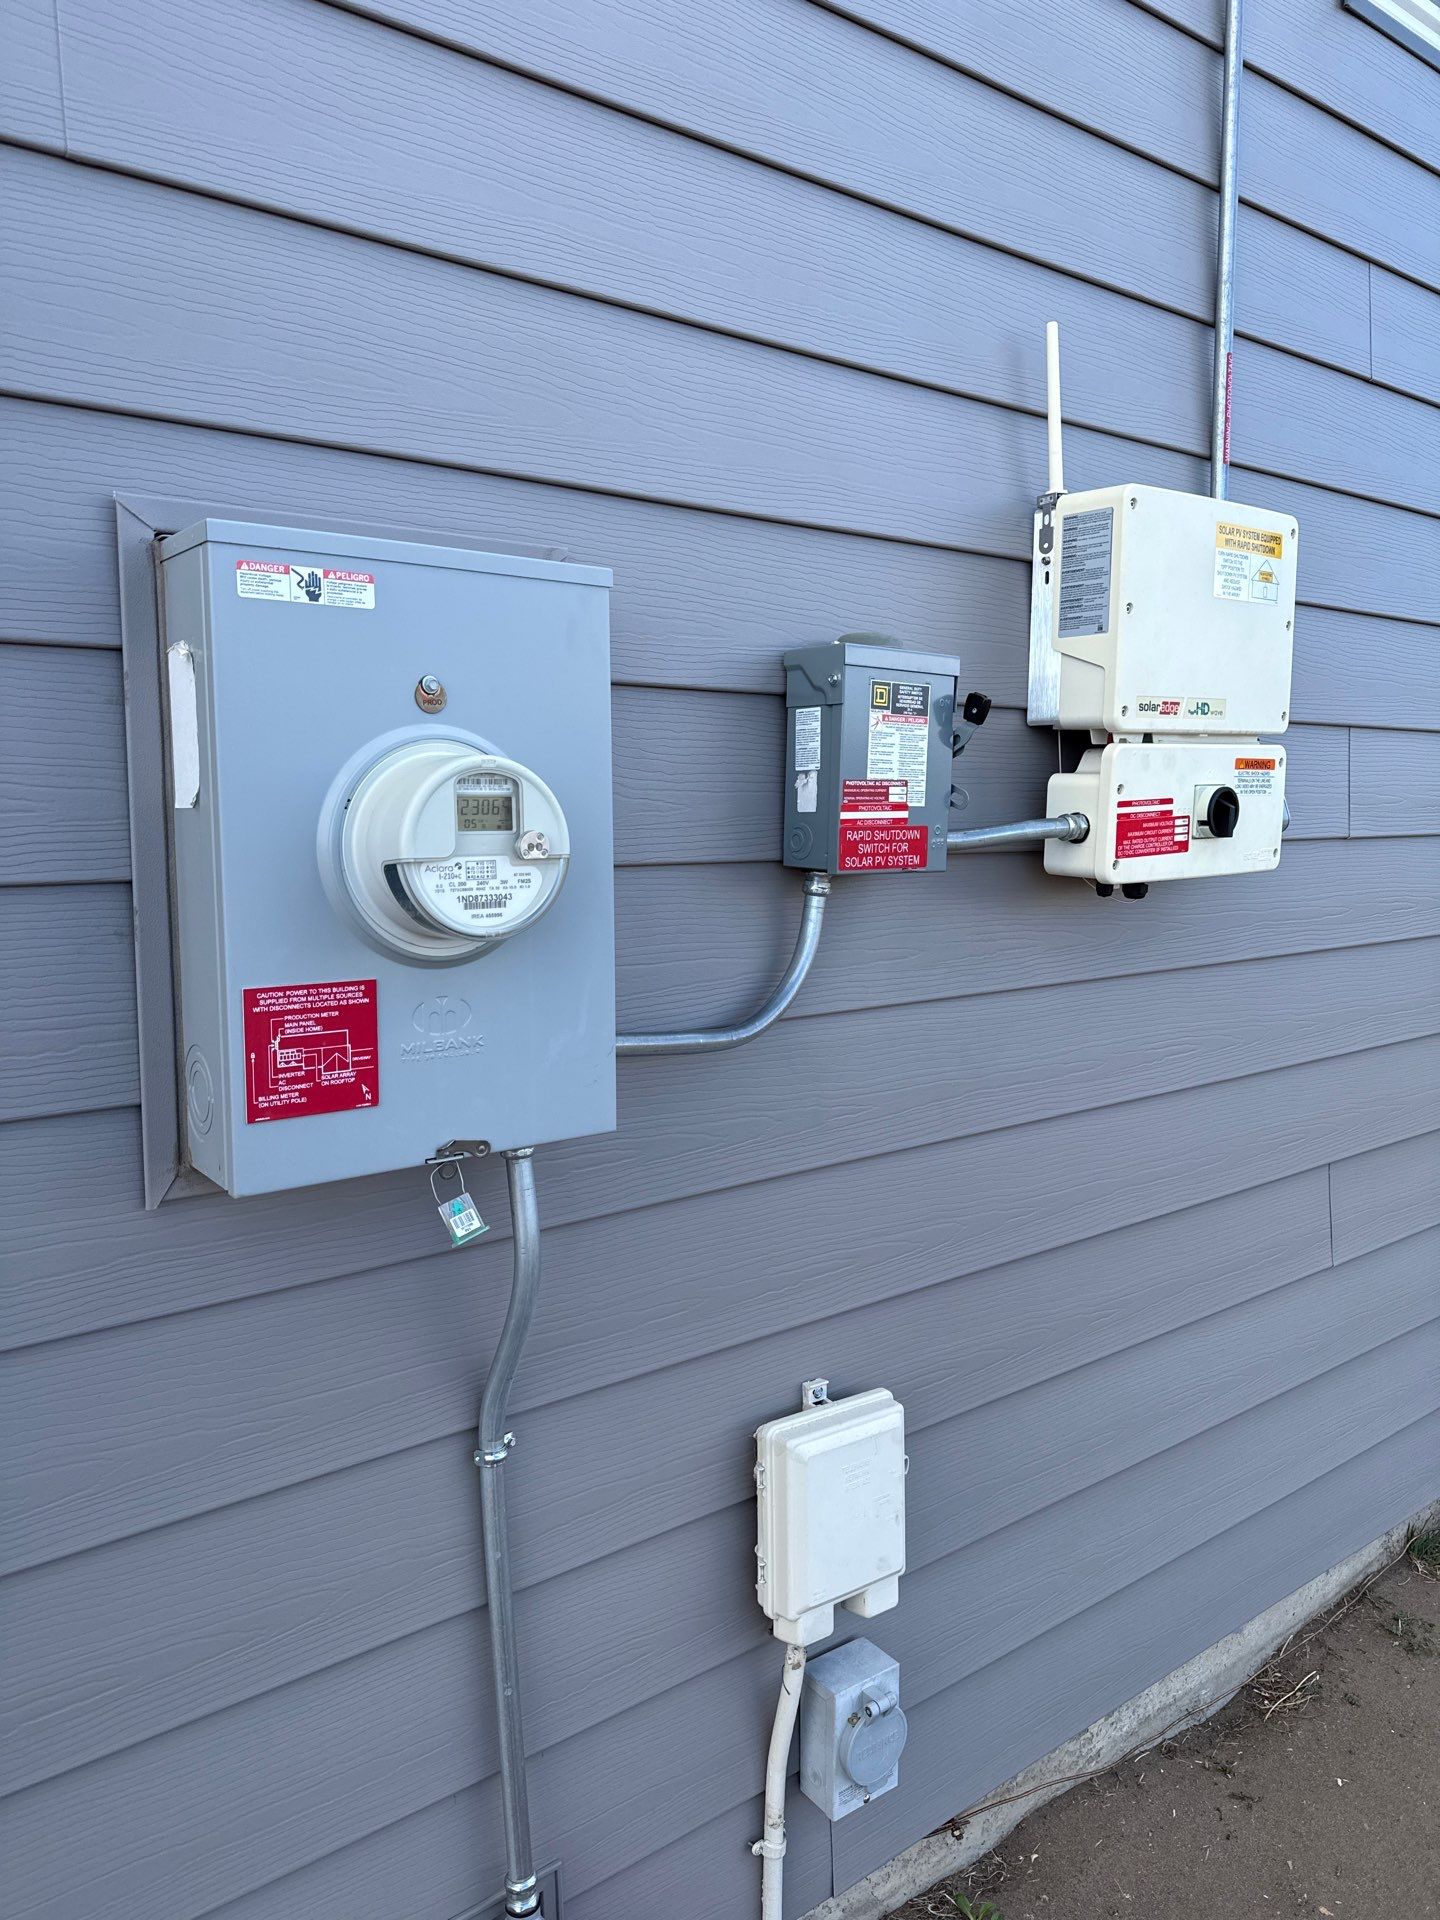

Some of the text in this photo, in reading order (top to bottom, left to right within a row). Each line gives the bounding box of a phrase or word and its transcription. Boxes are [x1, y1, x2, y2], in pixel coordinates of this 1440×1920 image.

[1219, 526, 1281, 546] SOLAR PV SYSTEM EQUIPPED
[1225, 538, 1275, 556] WITH RAPID SHUTDOWN
[250, 562, 285, 573] DANGER
[336, 573, 370, 582] PELIGRO
[1245, 760, 1270, 769] WARNING
[846, 830, 920, 841] RAPID SHUTDOWN
[858, 843, 909, 854] SWITCH FOR
[845, 855, 920, 867] SOLAR PV SYSTEM
[456, 893, 512, 903] 1ND87333043
[333, 985, 358, 993] BUILDING
[259, 998, 288, 1006] SUPPLIED
[270, 1004, 311, 1012] DISCONNECTS
[278, 1083, 313, 1091] DISCONNECT
[270, 1099, 289, 1107] UTILITY
